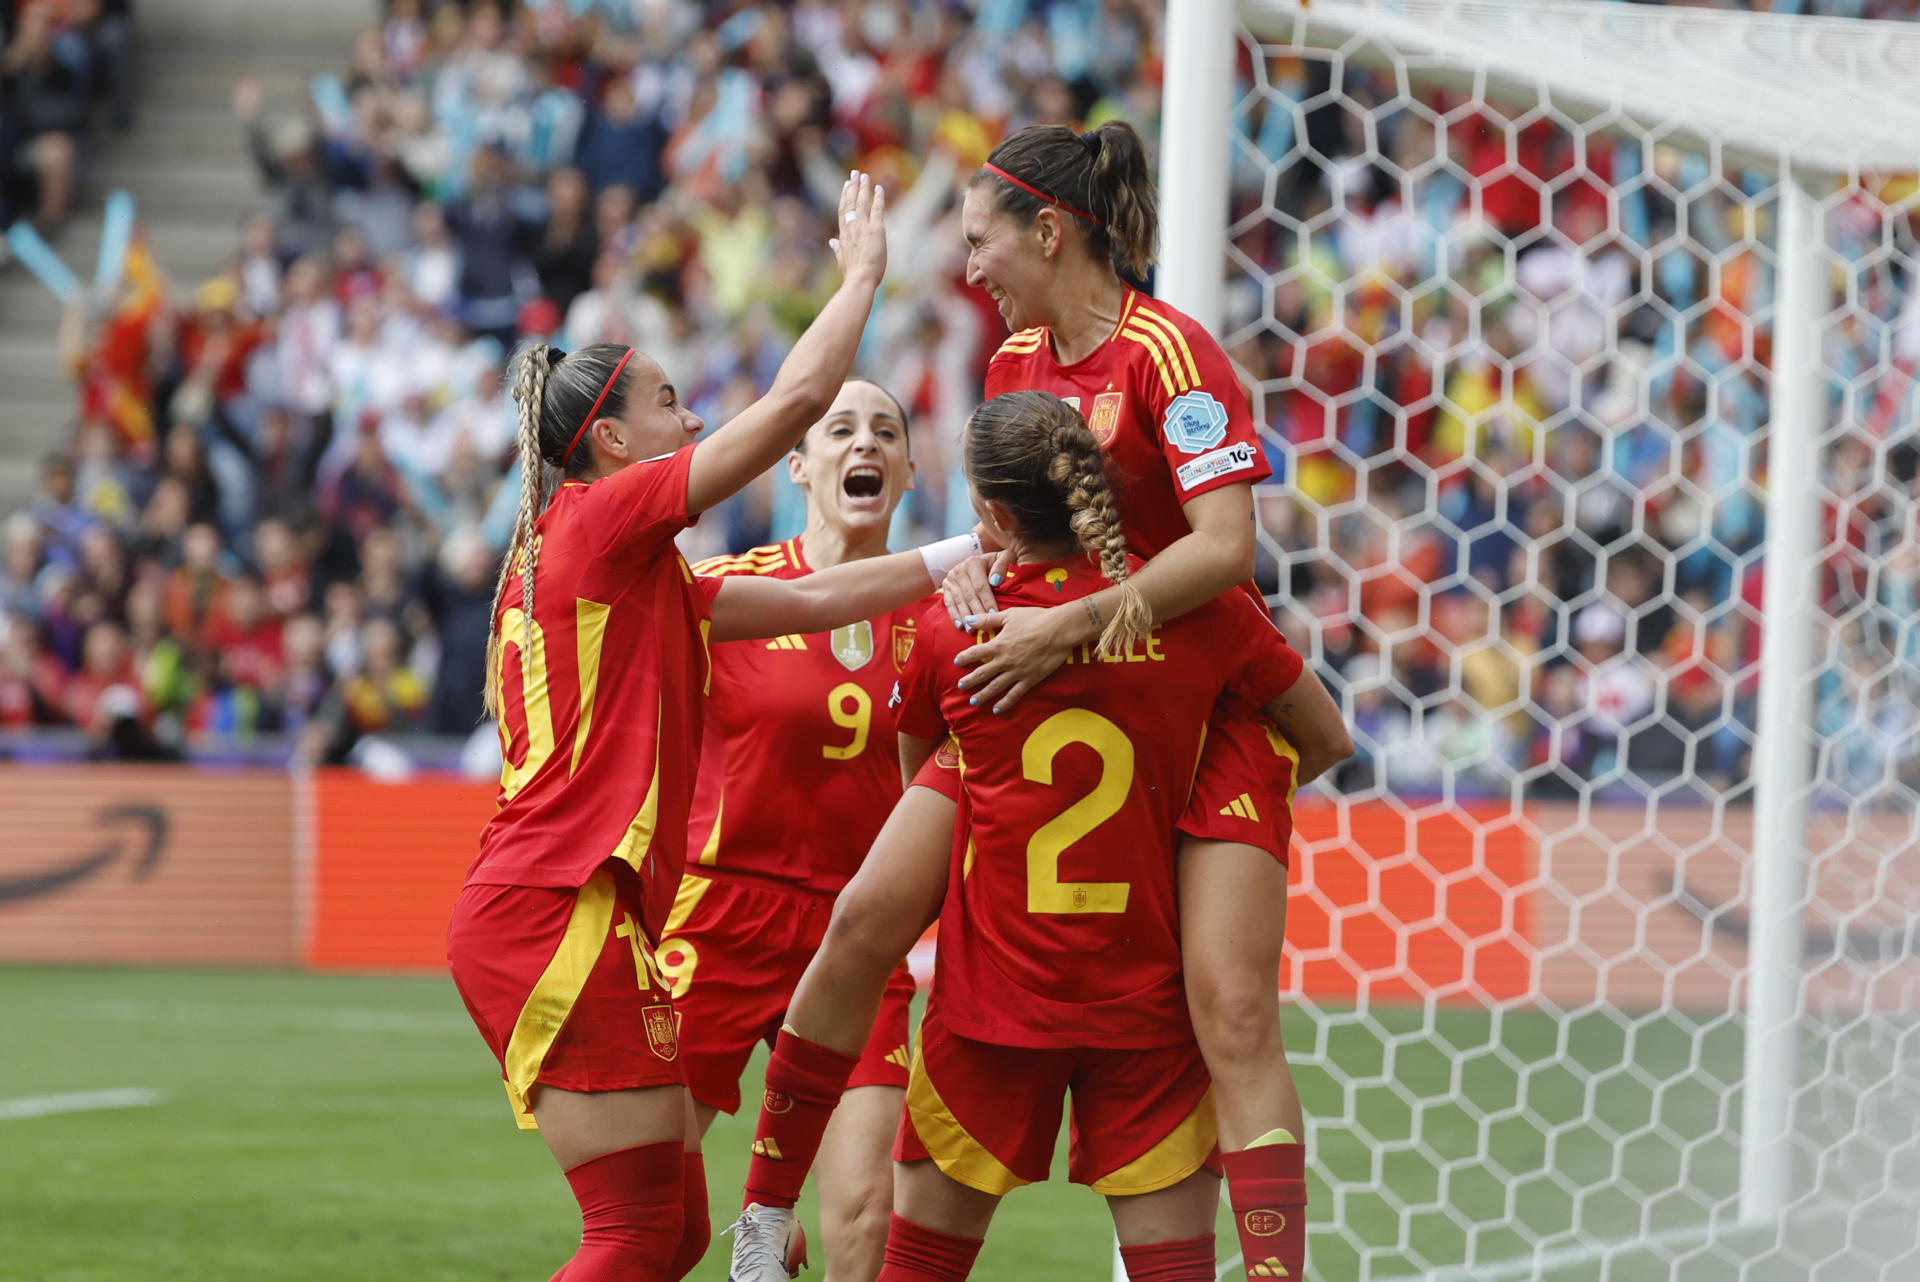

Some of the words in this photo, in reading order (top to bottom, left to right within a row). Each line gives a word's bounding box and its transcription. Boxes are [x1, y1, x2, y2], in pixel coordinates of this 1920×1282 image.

[1181, 456, 1230, 481] FOUNDATION
[822, 682, 872, 760] 9
[1021, 708, 1135, 914] 2
[654, 937, 699, 1000] 9
